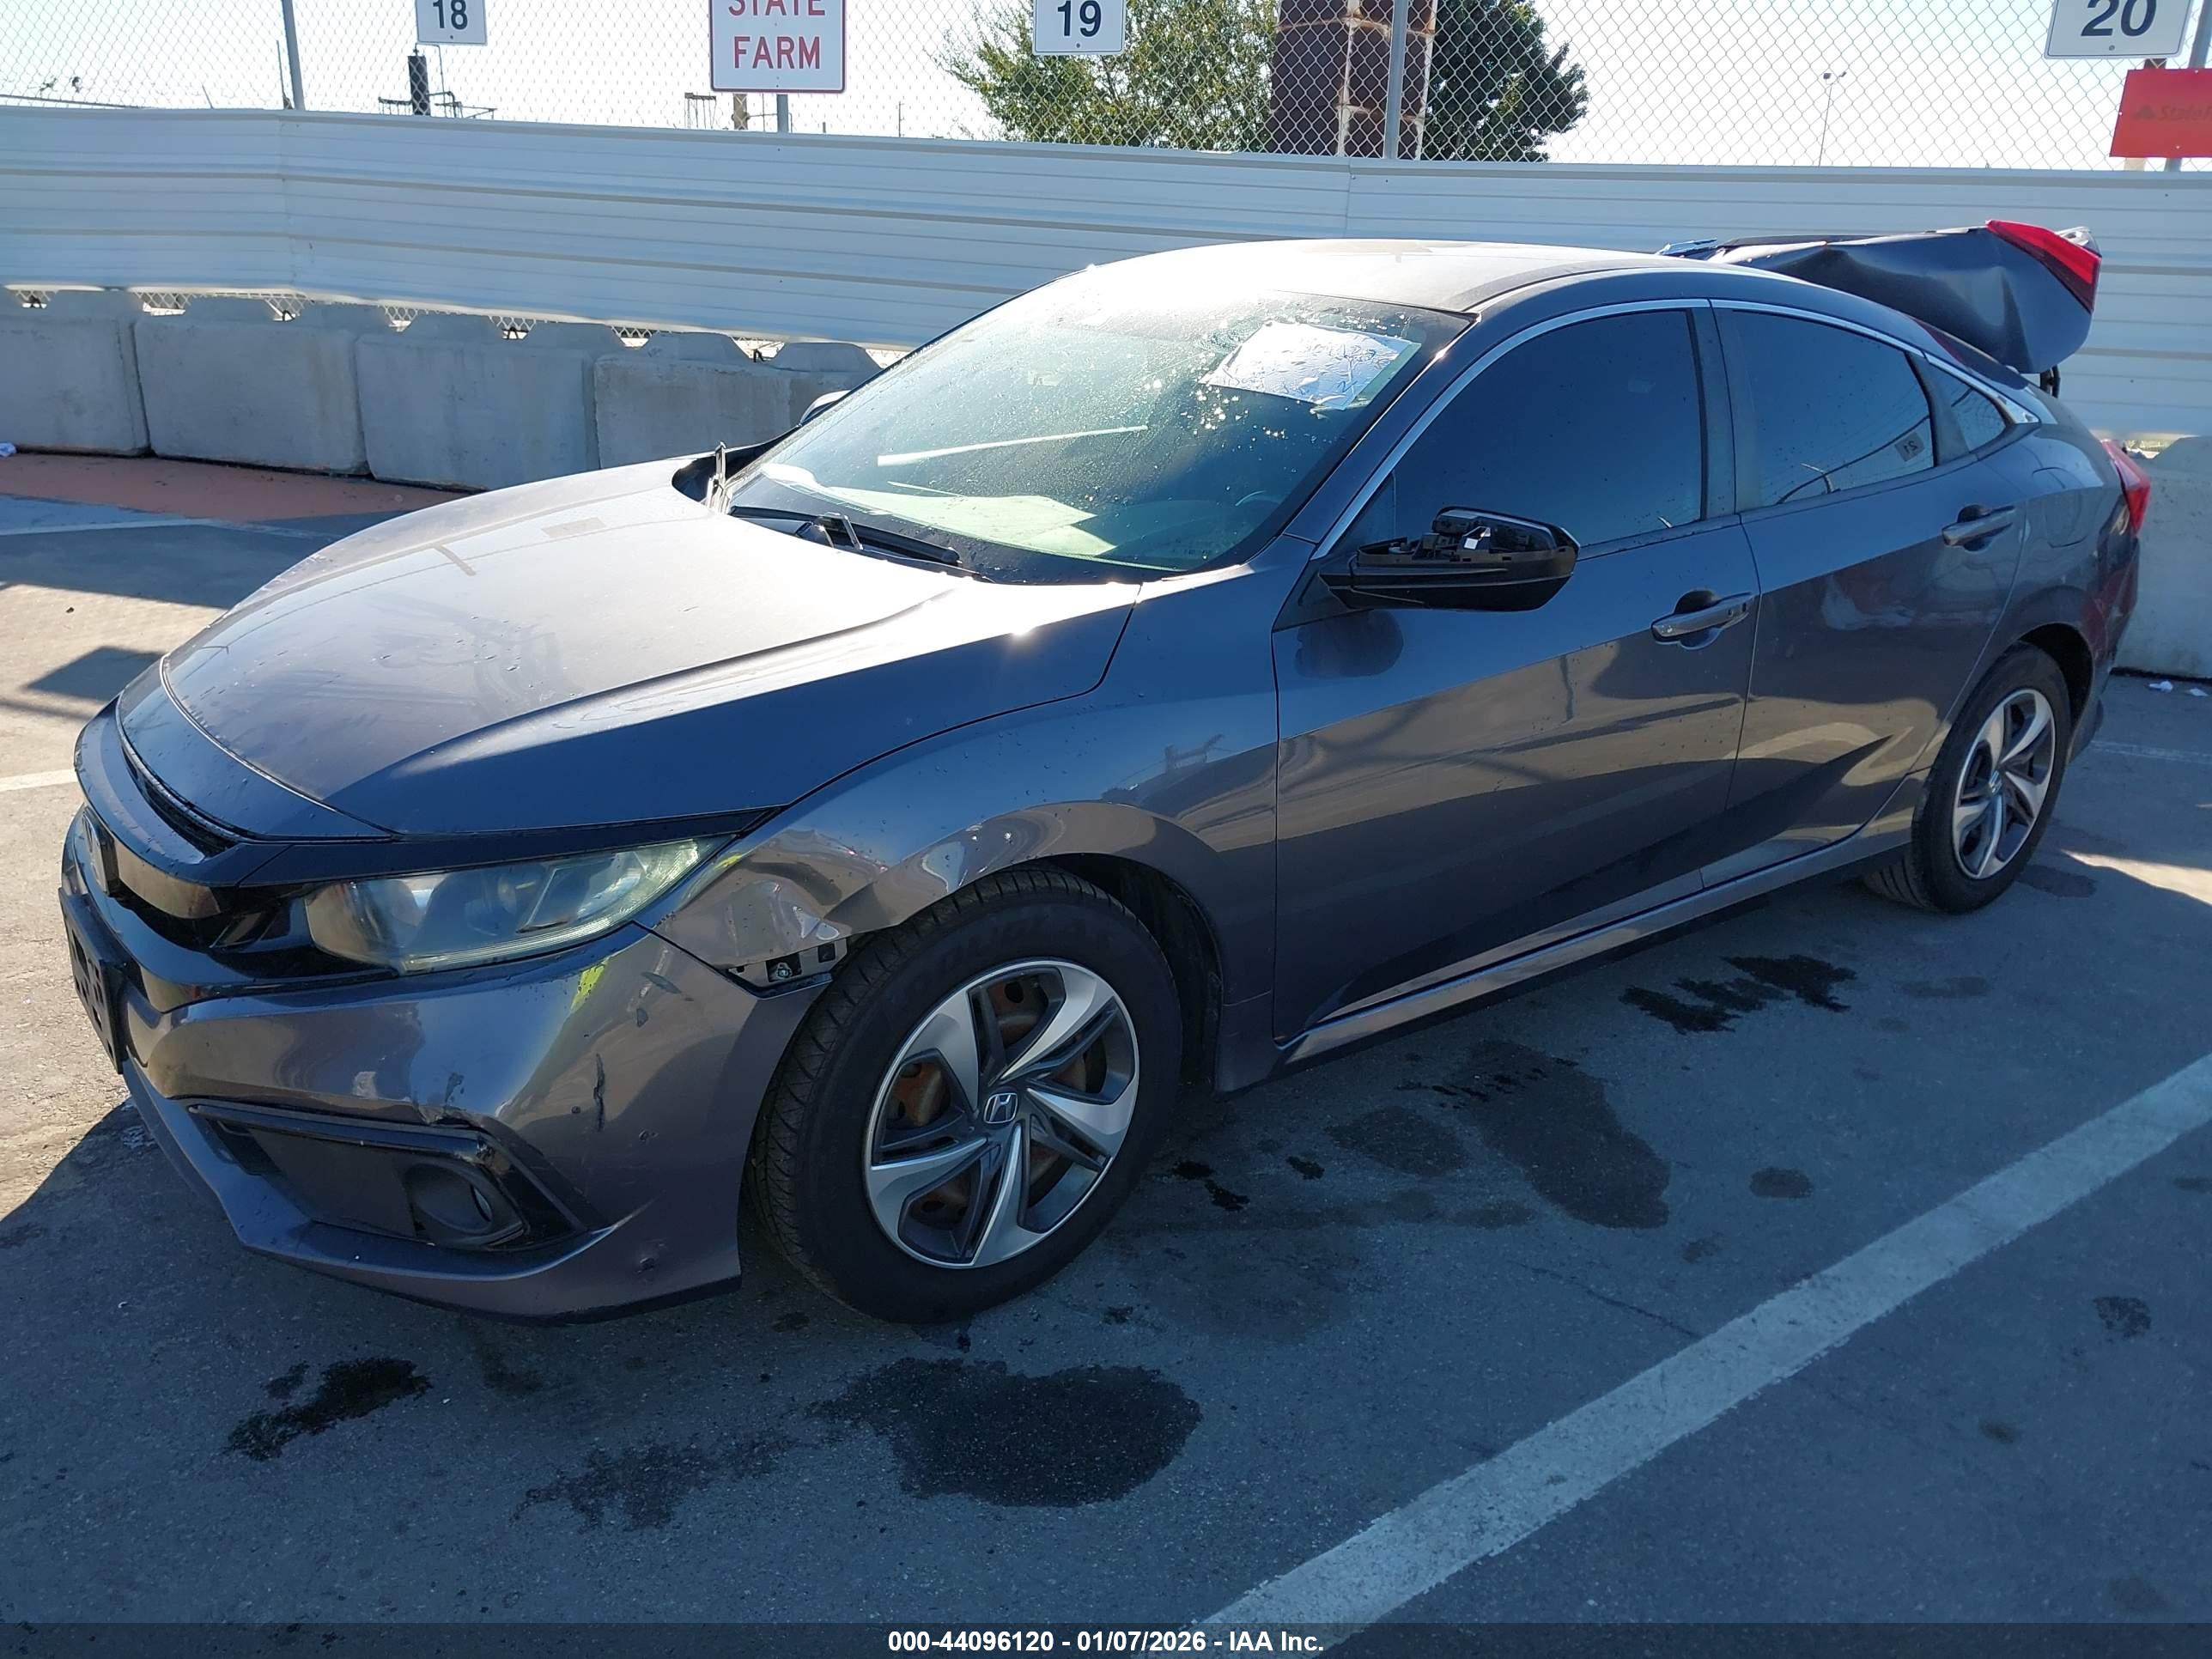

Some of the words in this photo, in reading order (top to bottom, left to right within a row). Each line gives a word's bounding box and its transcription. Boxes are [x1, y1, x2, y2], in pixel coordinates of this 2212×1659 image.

[432, 0, 468, 30] 18
[1057, 0, 1102, 37] 19
[2081, 0, 2157, 37] 20
[733, 36, 821, 70] FARM
